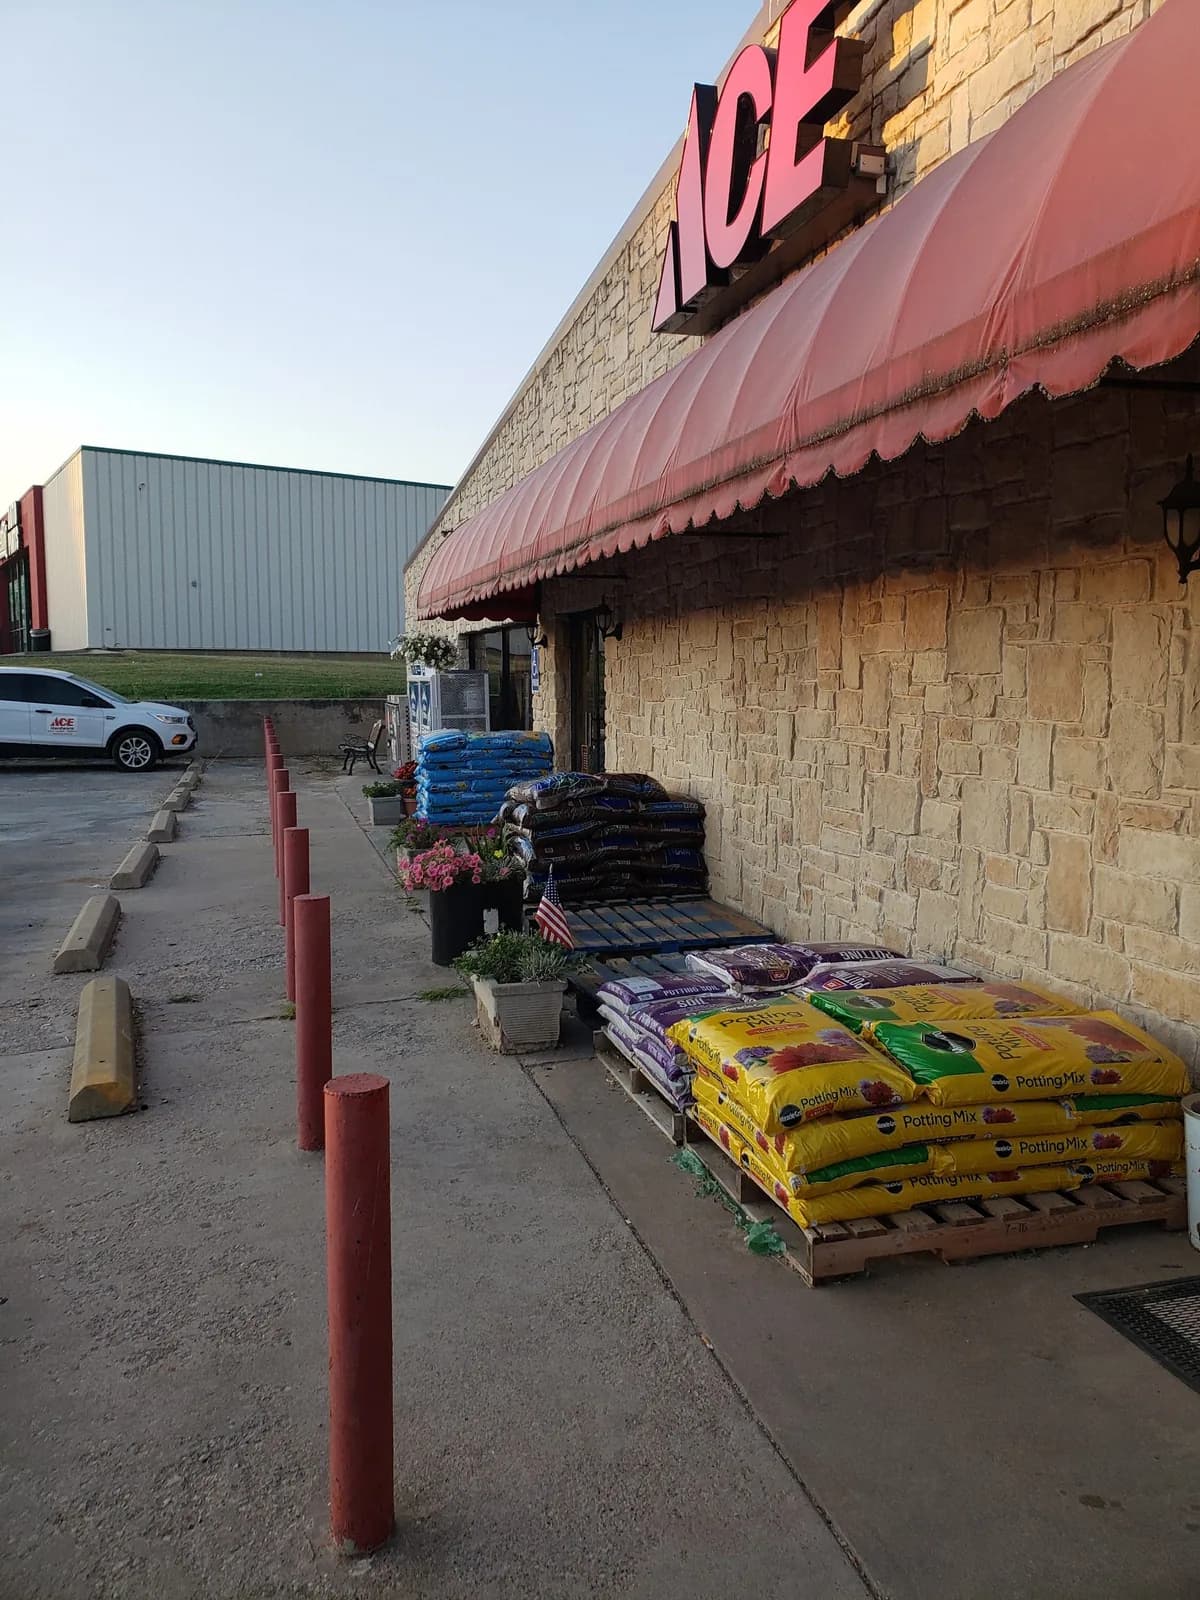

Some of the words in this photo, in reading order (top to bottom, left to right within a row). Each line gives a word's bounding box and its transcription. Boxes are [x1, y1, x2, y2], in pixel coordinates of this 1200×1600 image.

[651, 0, 840, 333] ACE
[51, 717, 75, 727] ACE
[663, 986, 699, 996] POTTING
[700, 984, 721, 992] SOIL
[677, 997, 707, 1008] SOIL
[720, 1011, 804, 1027] Potting
[748, 1019, 790, 1028] Mix
[1016, 1074, 1063, 1089] Potting
[1062, 1071, 1086, 1085] Mix
[801, 1090, 839, 1108] Potting
[839, 1086, 859, 1098] Mix
[903, 1112, 952, 1128] Potting
[953, 1110, 977, 1124] Mix
[1020, 1138, 1065, 1155] Potting
[1066, 1136, 1088, 1150] Mix
[1096, 1162, 1129, 1173] Potting
[1128, 1160, 1146, 1171] Mix
